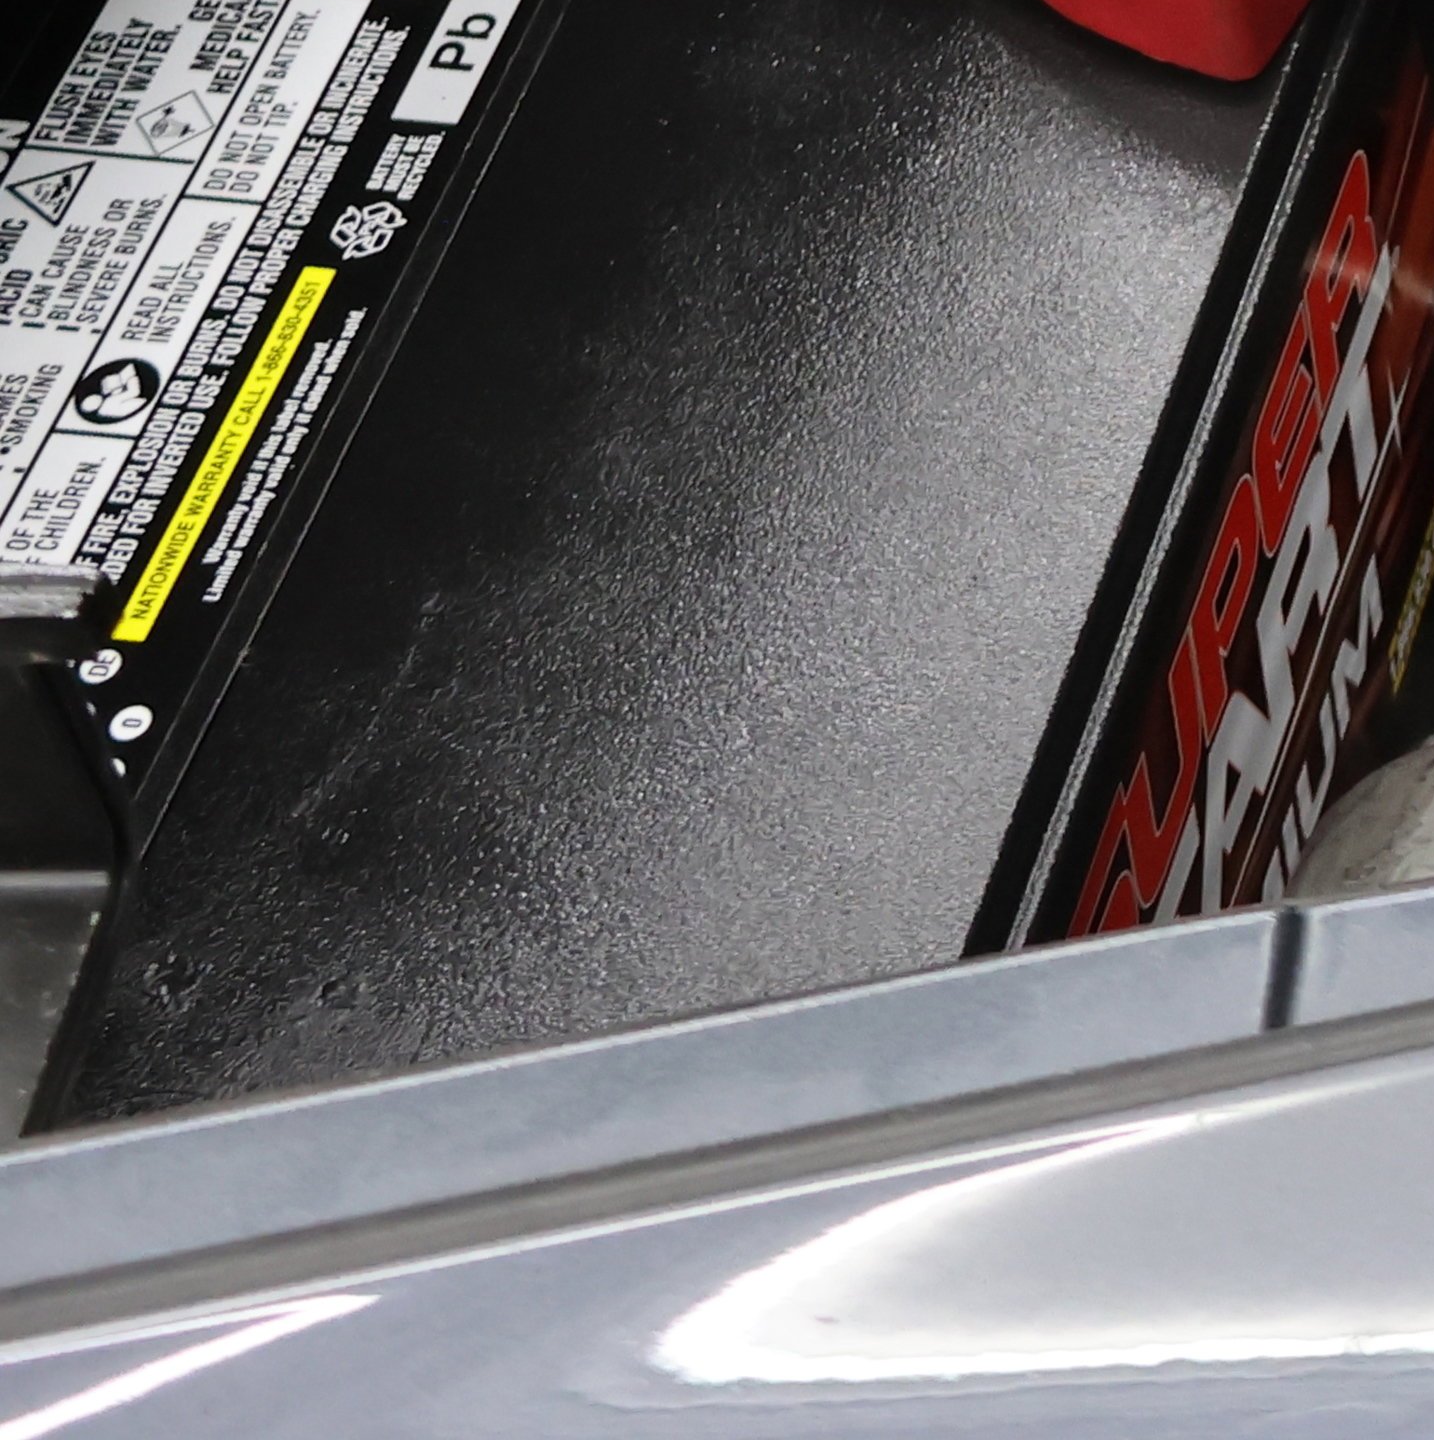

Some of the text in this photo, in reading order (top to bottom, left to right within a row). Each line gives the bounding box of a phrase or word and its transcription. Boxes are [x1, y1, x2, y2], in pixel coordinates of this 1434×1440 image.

[62, 17, 155, 144] IMMEDIATELY
[205, 49, 253, 94] HELP
[319, 15, 390, 108] INCINERATE.
[427, 10, 501, 72] Pb
[33, 31, 118, 141] FLUSH EYES
[90, 22, 182, 147] WITH WATER.
[202, 8, 321, 190] DO NOT OPEN BATTERY.
[304, 110, 339, 135] OR
[326, 23, 414, 142] INSTRUCTIONS.
[228, 100, 298, 192] DO NOT TIP.
[283, 144, 349, 226] CHARGING
[362, 133, 409, 190] BATTERY
[380, 155, 415, 191] MUST
[395, 130, 448, 200] RECYCLED.
[245, 137, 326, 246] DISASSEMBLE
[0, 268, 34, 316] ACID
[16, 224, 90, 318] CAN CAUSE
[46, 198, 134, 321] BLINDNESS OR
[73, 193, 167, 323] SEVERE BURNS.
[145, 215, 236, 343] INSTRUCTIONS.
[210, 284, 246, 311] DO
[226, 247, 266, 282] NOT
[246, 228, 304, 294] PROPER
[119, 260, 184, 340] READ ALL
[208, 295, 269, 365] FOLLOW
[175, 313, 232, 377] BURNS.
[159, 379, 196, 405] OR
[185, 369, 230, 409] USE.
[106, 407, 181, 504] EXPLOSION
[139, 412, 207, 496] INVERTED
[200, 503, 250, 564] Warranty
[233, 471, 265, 501] void
[268, 398, 303, 432] label
[287, 338, 334, 398] removed.
[201, 550, 244, 602] Limited
[229, 490, 278, 548] warranty
[260, 455, 293, 488] valid
[319, 339, 352, 374] when
[337, 306, 368, 337] sold.
[4, 528, 38, 551] OF
[19, 488, 59, 523] THE
[32, 455, 106, 551] CHILDREN.
[79, 506, 131, 554] FIRE,
[118, 497, 162, 535] FOR
[130, 522, 196, 619] NATIONWIDE
[183, 430, 244, 516] WARRANTY
[231, 386, 266, 426] CALL
[1262, 554, 1383, 906] IUM
